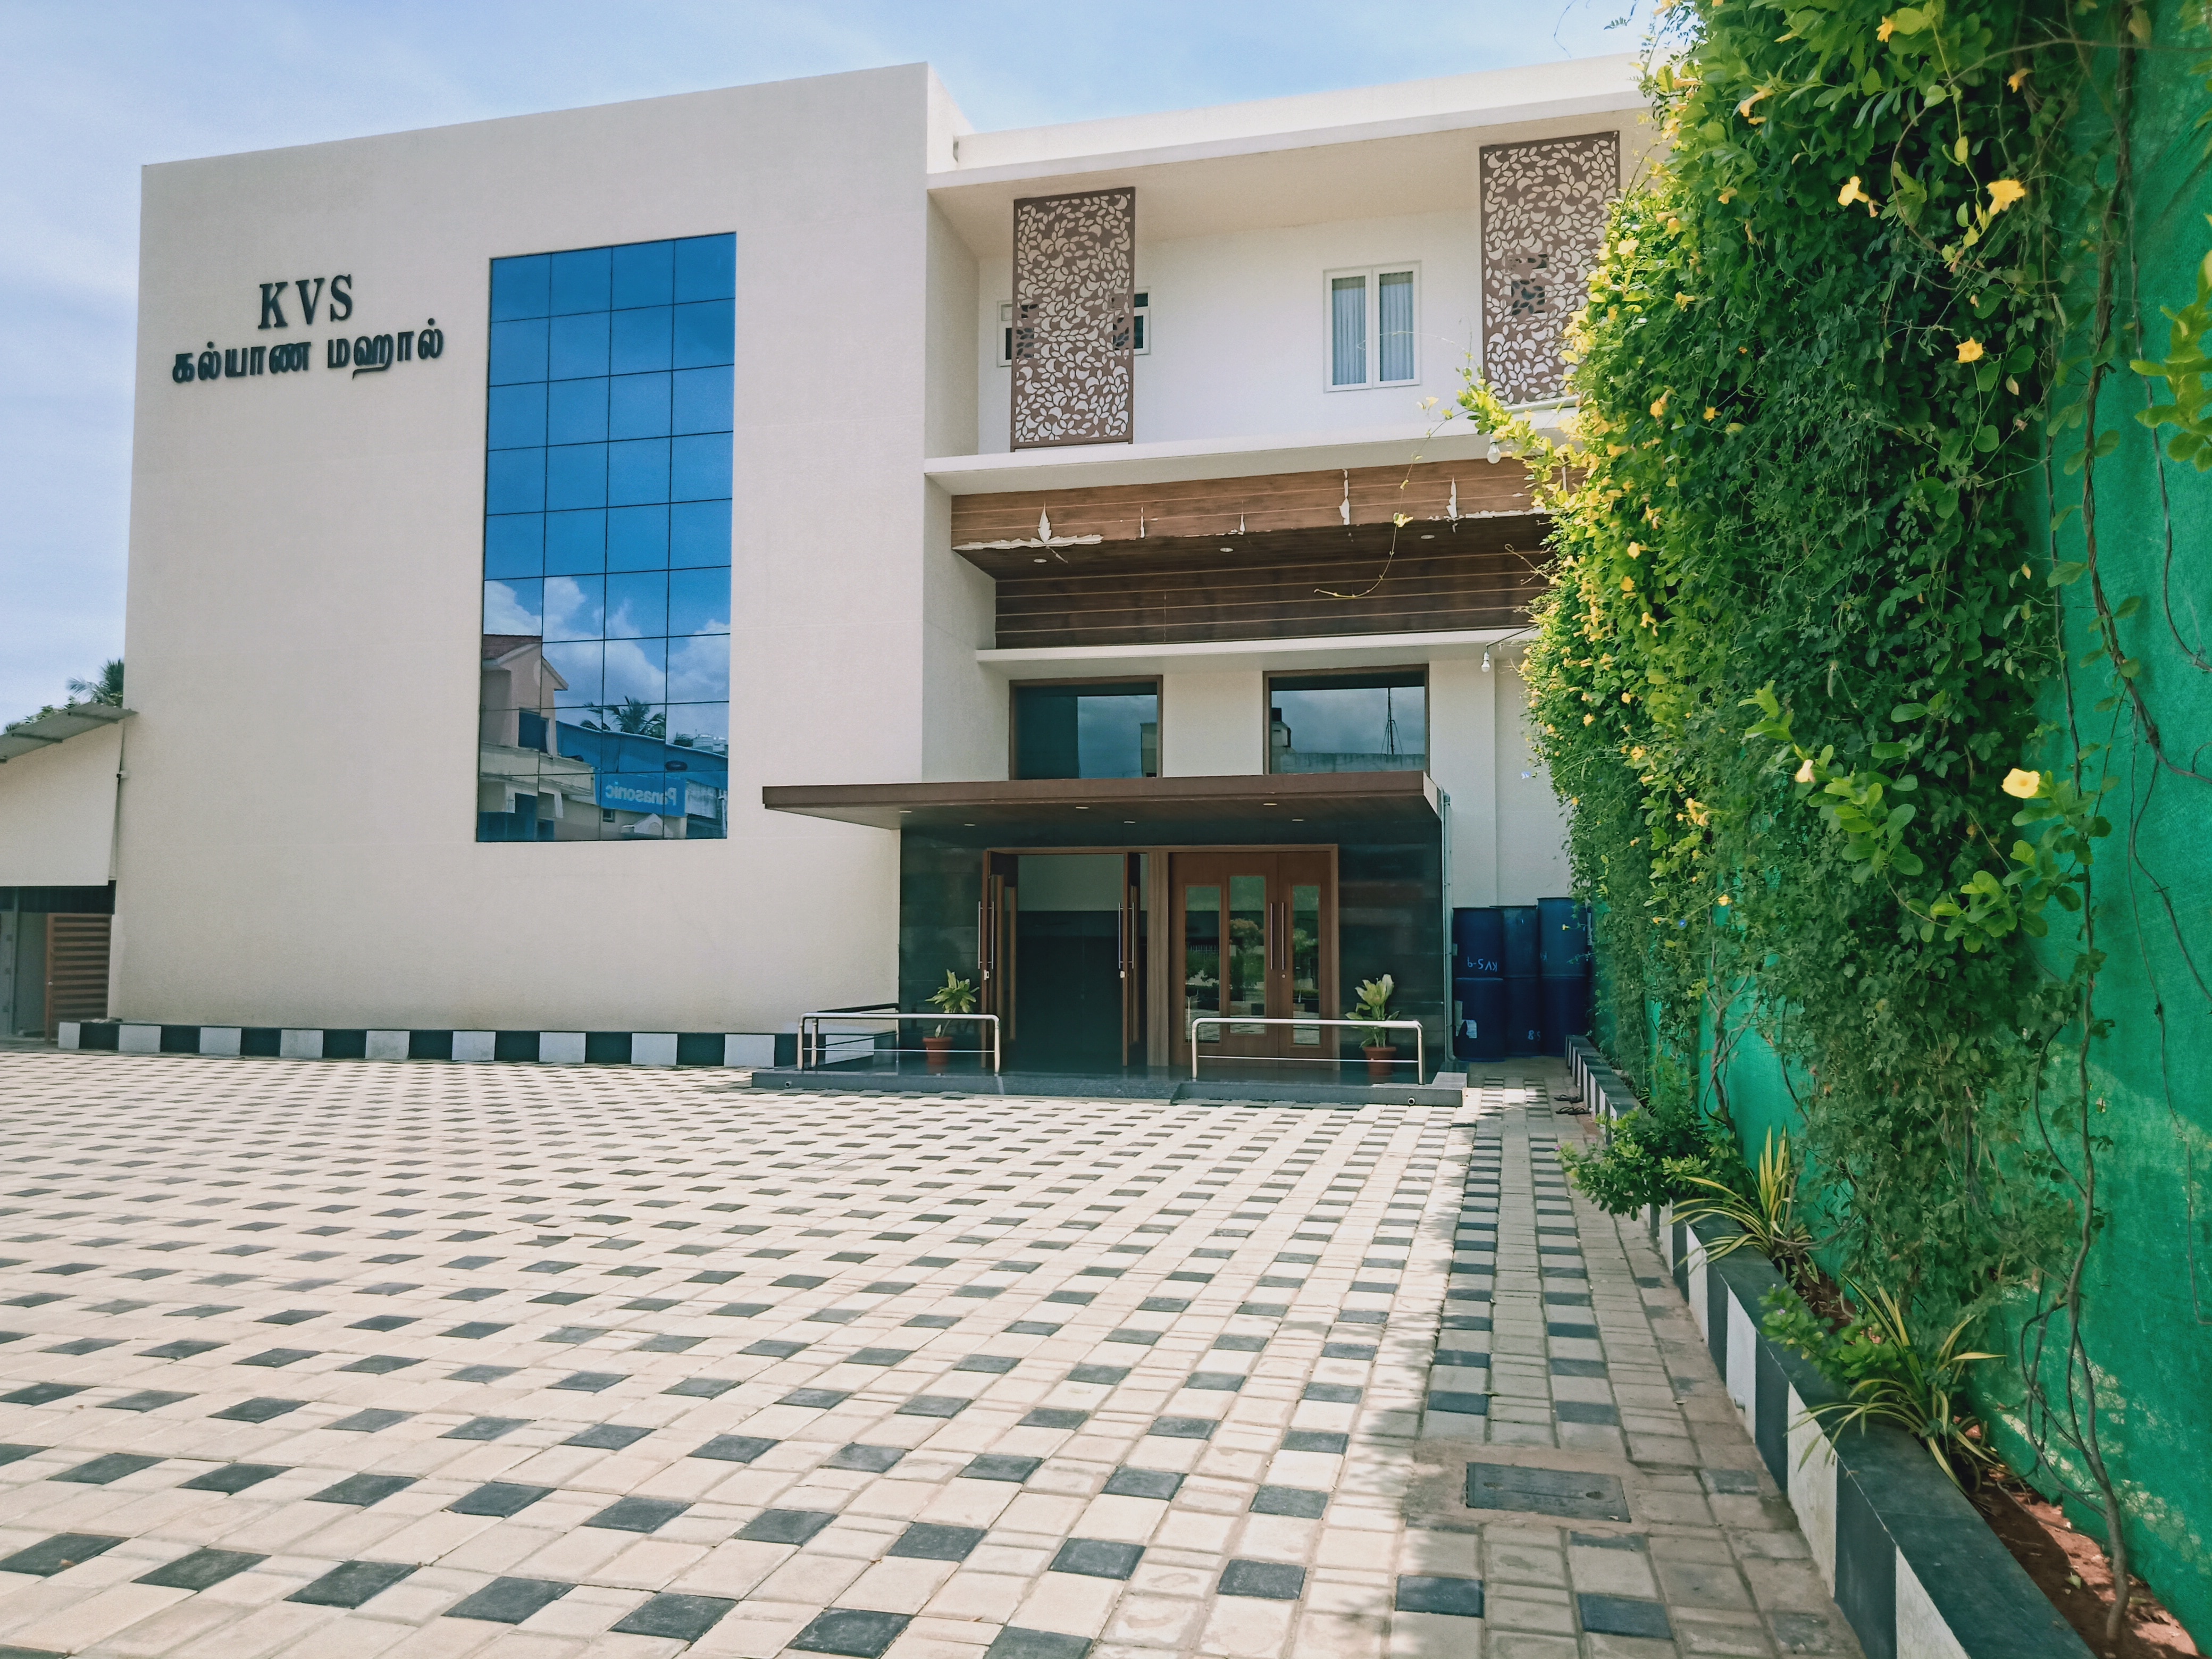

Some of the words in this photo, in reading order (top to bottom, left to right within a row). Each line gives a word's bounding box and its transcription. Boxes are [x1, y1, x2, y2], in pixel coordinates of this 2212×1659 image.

[258, 274, 353, 329] KVS
[172, 341, 311, 383] கல்யாண
[328, 318, 443, 379] மஹால்
